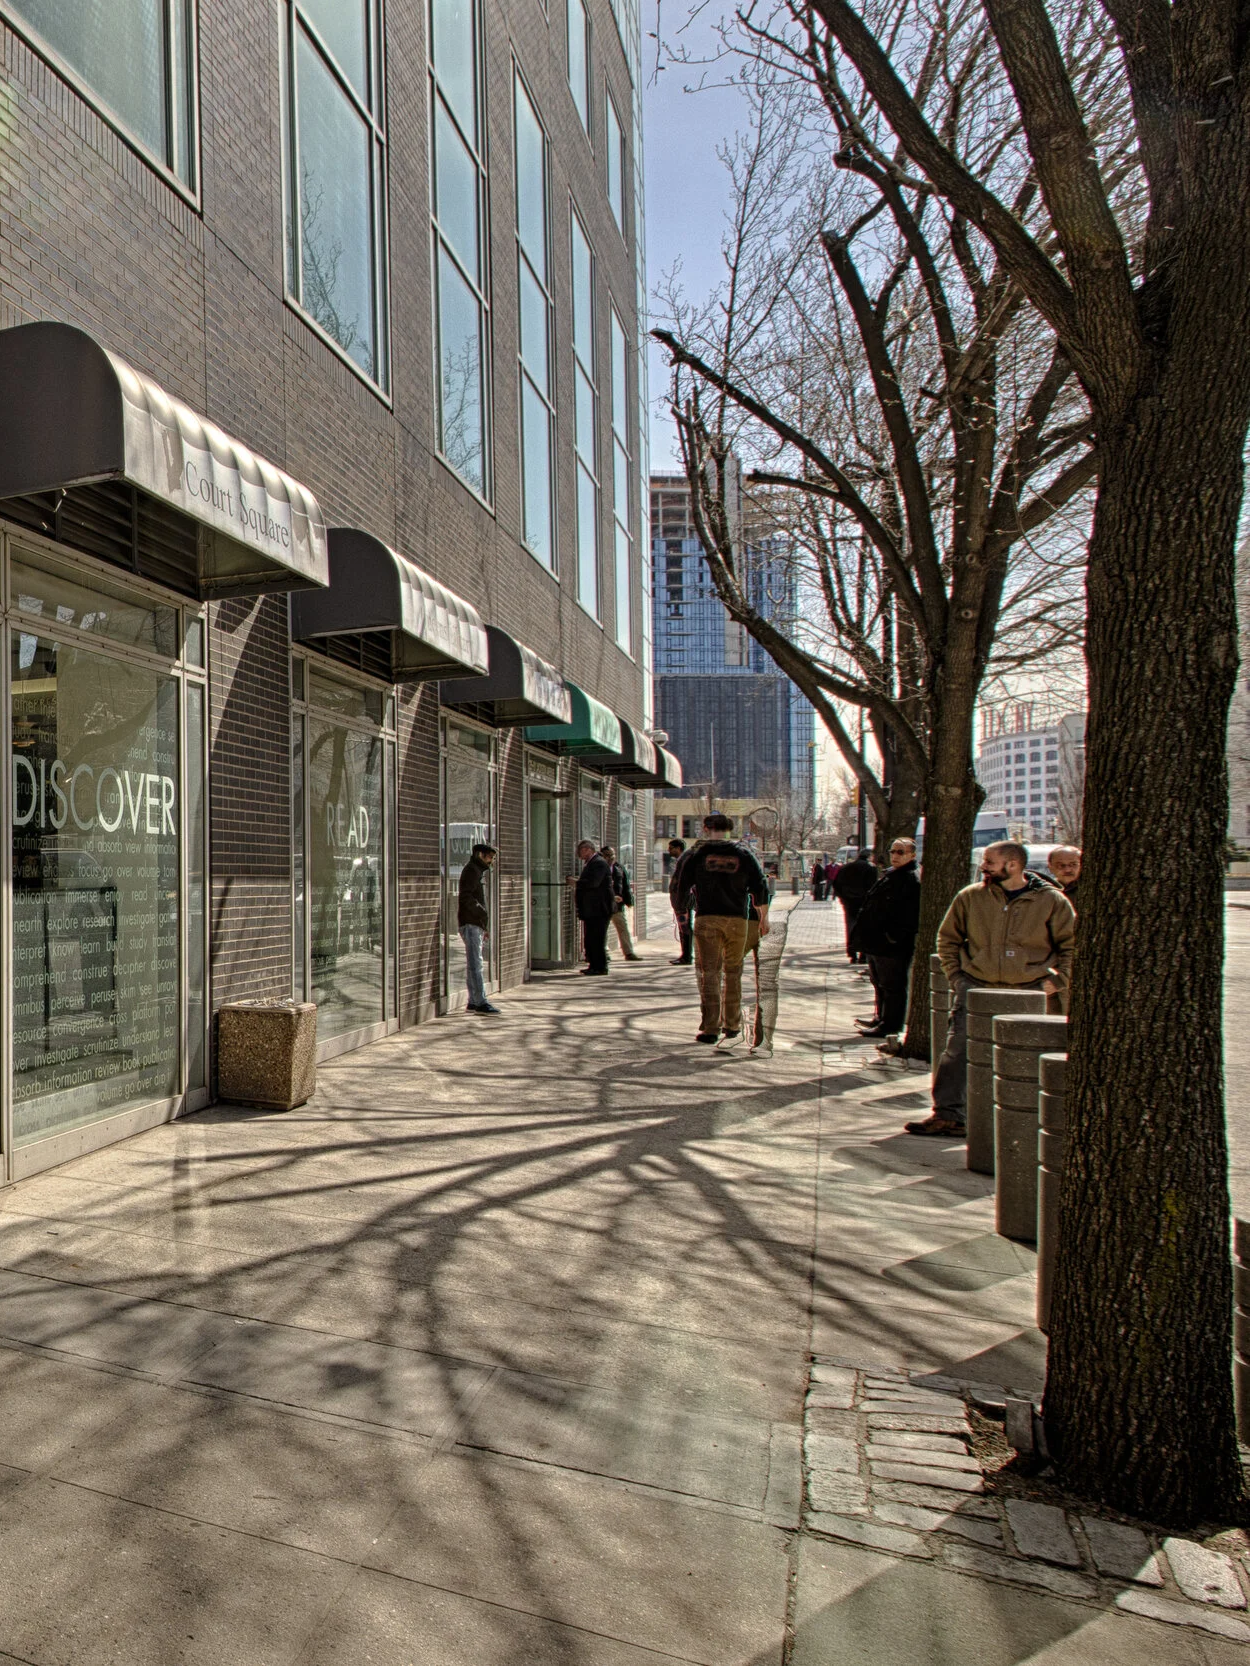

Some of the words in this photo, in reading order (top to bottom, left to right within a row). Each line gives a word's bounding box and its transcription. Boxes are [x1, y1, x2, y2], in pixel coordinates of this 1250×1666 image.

[185, 460, 234, 519] Court
[238, 491, 290, 549] Square
[12, 754, 177, 836] DISCOVER
[326, 801, 370, 849] READ
[47, 910, 79, 936] explore
[13, 994, 45, 1017] mnibus
[13, 1075, 42, 1099] bsorb
[94, 1060, 121, 1078] review
[122, 1049, 141, 1072] book
